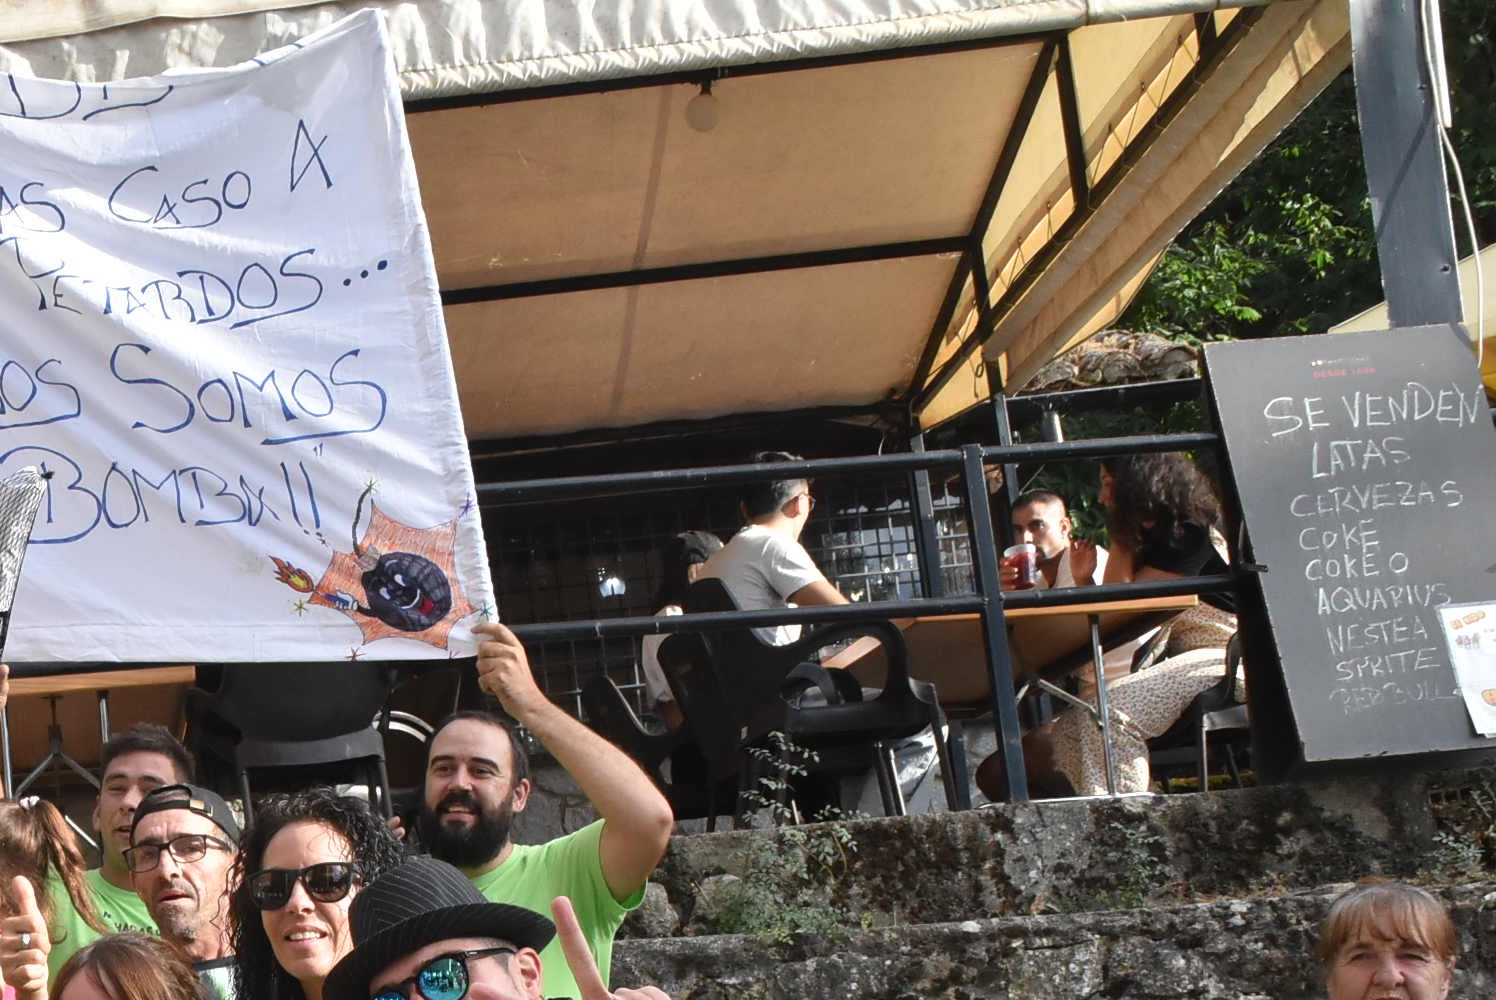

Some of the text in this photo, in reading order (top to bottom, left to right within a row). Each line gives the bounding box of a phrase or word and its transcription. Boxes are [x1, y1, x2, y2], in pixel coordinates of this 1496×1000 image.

[109, 165, 251, 230] CASO
[288, 118, 333, 190] A
[109, 342, 388, 447] SOMOS
[1264, 382, 1483, 437] SE VENDEN
[1312, 436, 1411, 479] LATAS
[1290, 480, 1464, 518] CERVEZAS
[1299, 518, 1380, 552] COKE
[1305, 553, 1380, 581] COKE
[1318, 583, 1452, 616] AQUARIUS
[1326, 616, 1429, 655] NESTEA
[1336, 647, 1441, 681] SPRITE
